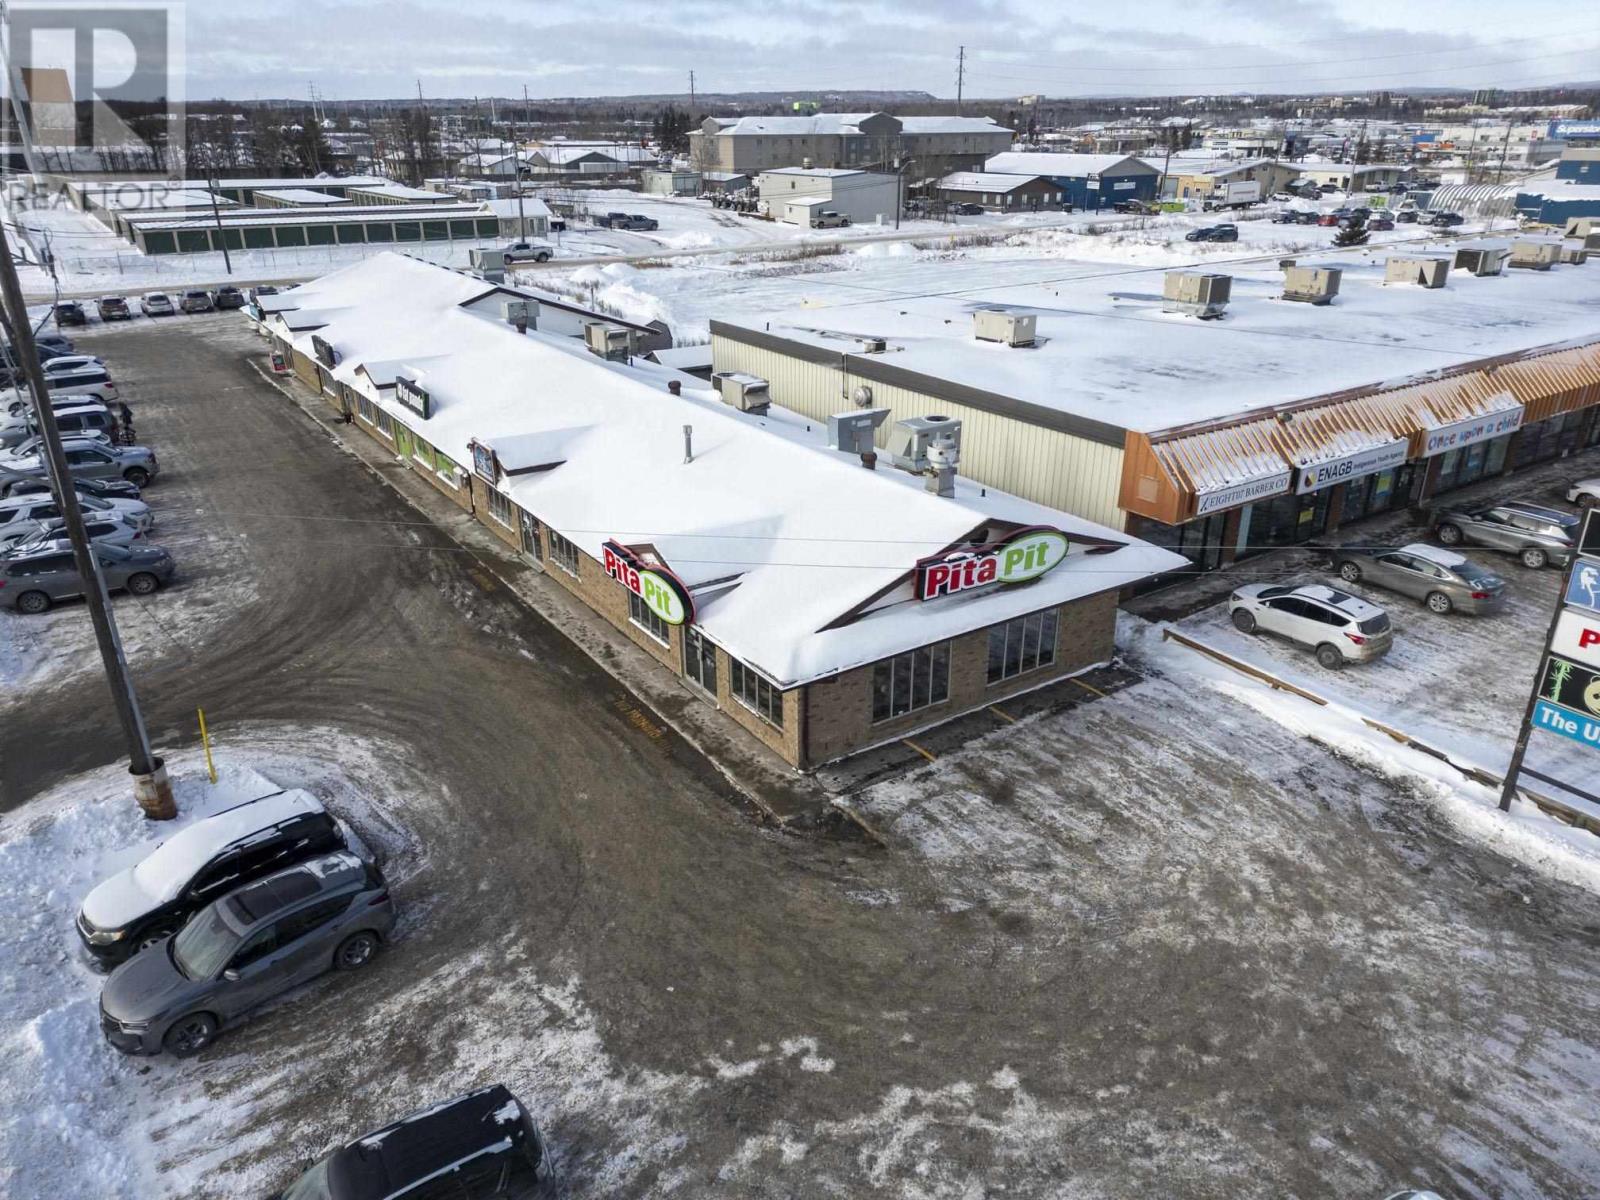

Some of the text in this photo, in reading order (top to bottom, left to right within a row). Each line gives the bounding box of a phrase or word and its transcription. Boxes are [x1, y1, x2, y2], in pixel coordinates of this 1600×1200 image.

[1428, 433, 1456, 451] Once
[1460, 424, 1484, 444] upon
[1497, 410, 1522, 433] child
[1245, 482, 1275, 498] BARBER
[1318, 461, 1353, 482] ENAGB
[604, 548, 672, 616] Pita Pit
[926, 541, 1049, 597] Pita Pit
[1541, 706, 1600, 743] The U
